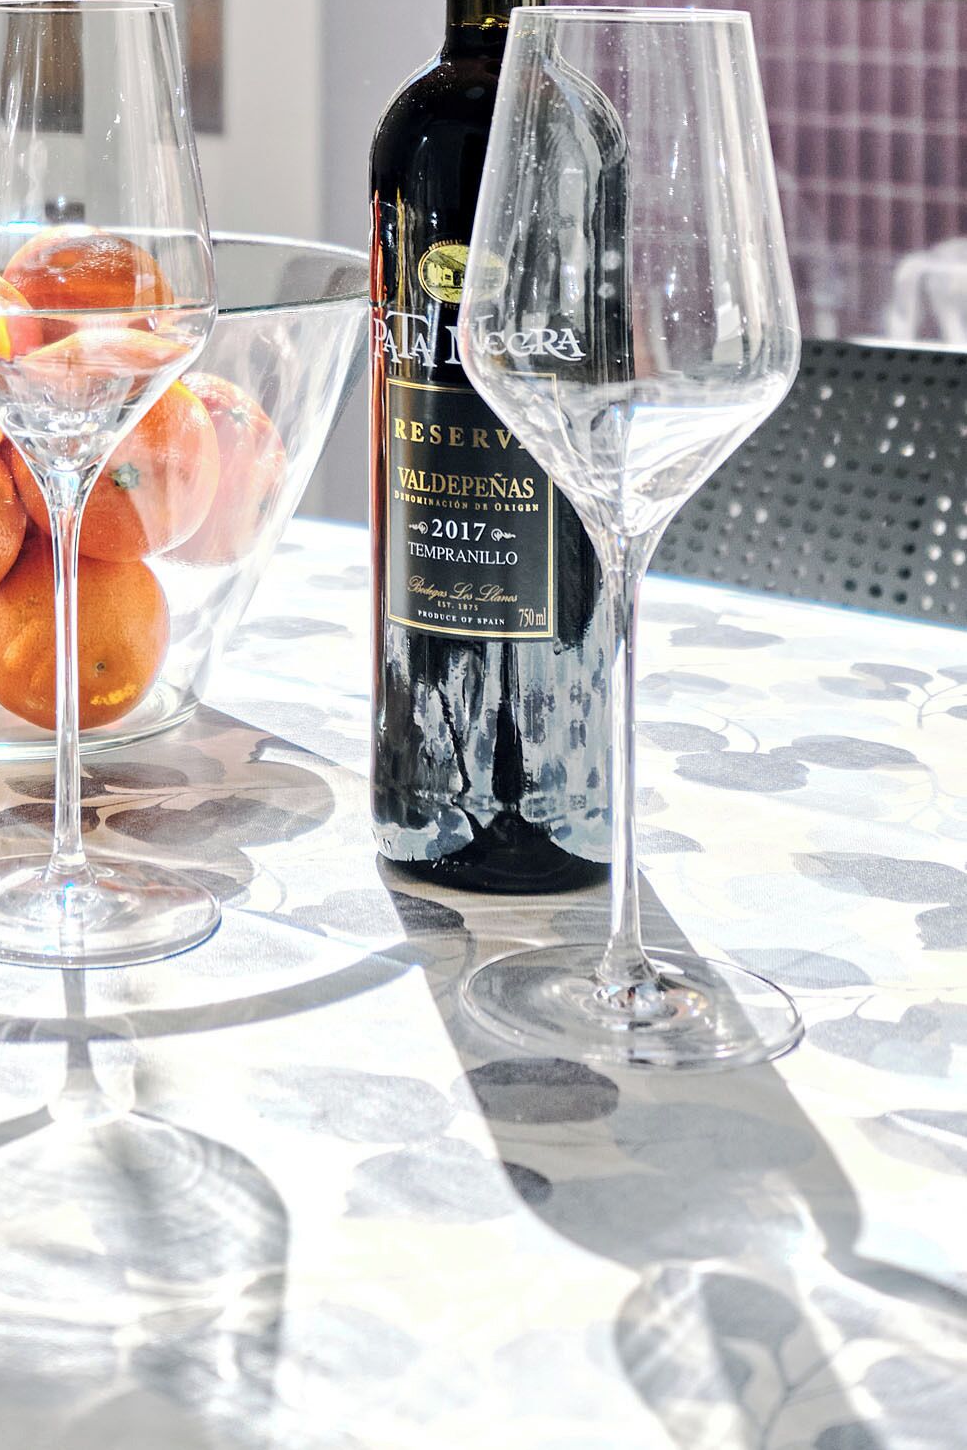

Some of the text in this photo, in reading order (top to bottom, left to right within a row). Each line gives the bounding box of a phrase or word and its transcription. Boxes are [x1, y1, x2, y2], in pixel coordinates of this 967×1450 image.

[373, 310, 587, 368] PATA NEGRA
[397, 466, 535, 499] VALDEPEÑAS
[394, 490, 469, 510] DENOMINACIÓN
[494, 502, 540, 512] ORIGEN
[431, 518, 487, 542] 2017
[408, 541, 518, 566] TEMPRANILLO
[406, 575, 518, 603] Bodegas Los Llanos
[417, 609, 506, 626] PRODUCE OF SPAIN
[437, 600, 479, 612] EST. 1875
[518, 608, 535, 628] 750
